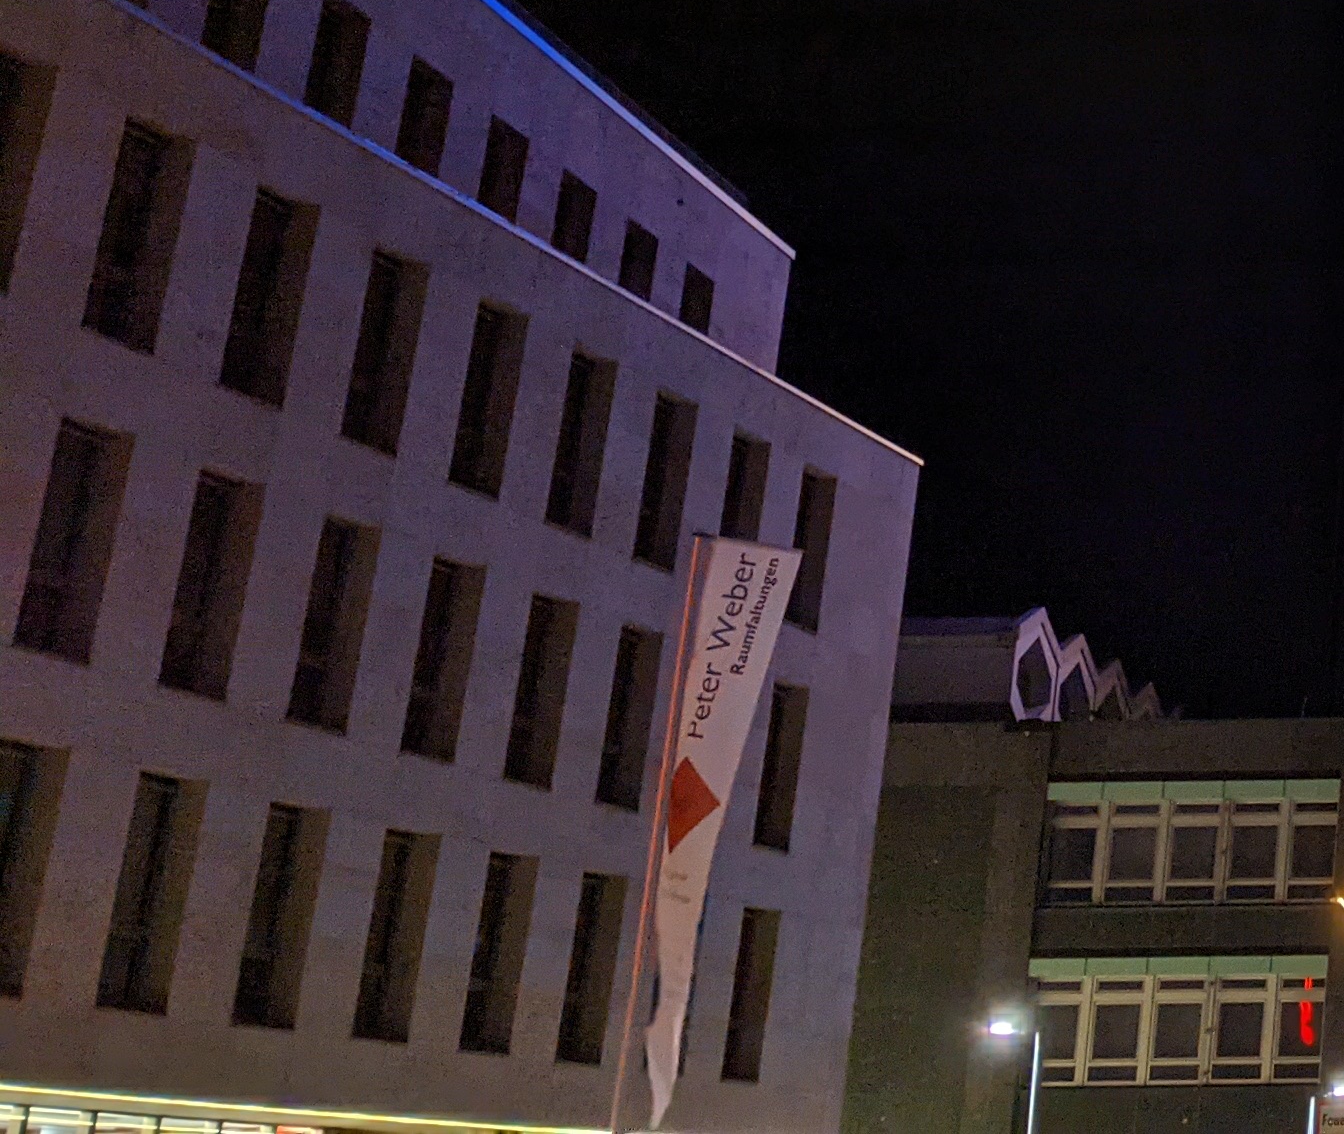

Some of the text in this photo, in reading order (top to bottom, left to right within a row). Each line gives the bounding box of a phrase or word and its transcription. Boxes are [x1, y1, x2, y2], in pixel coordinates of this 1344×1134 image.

[688, 553, 756, 738] Peter Weber
[730, 558, 779, 674] Raumfaltungen
